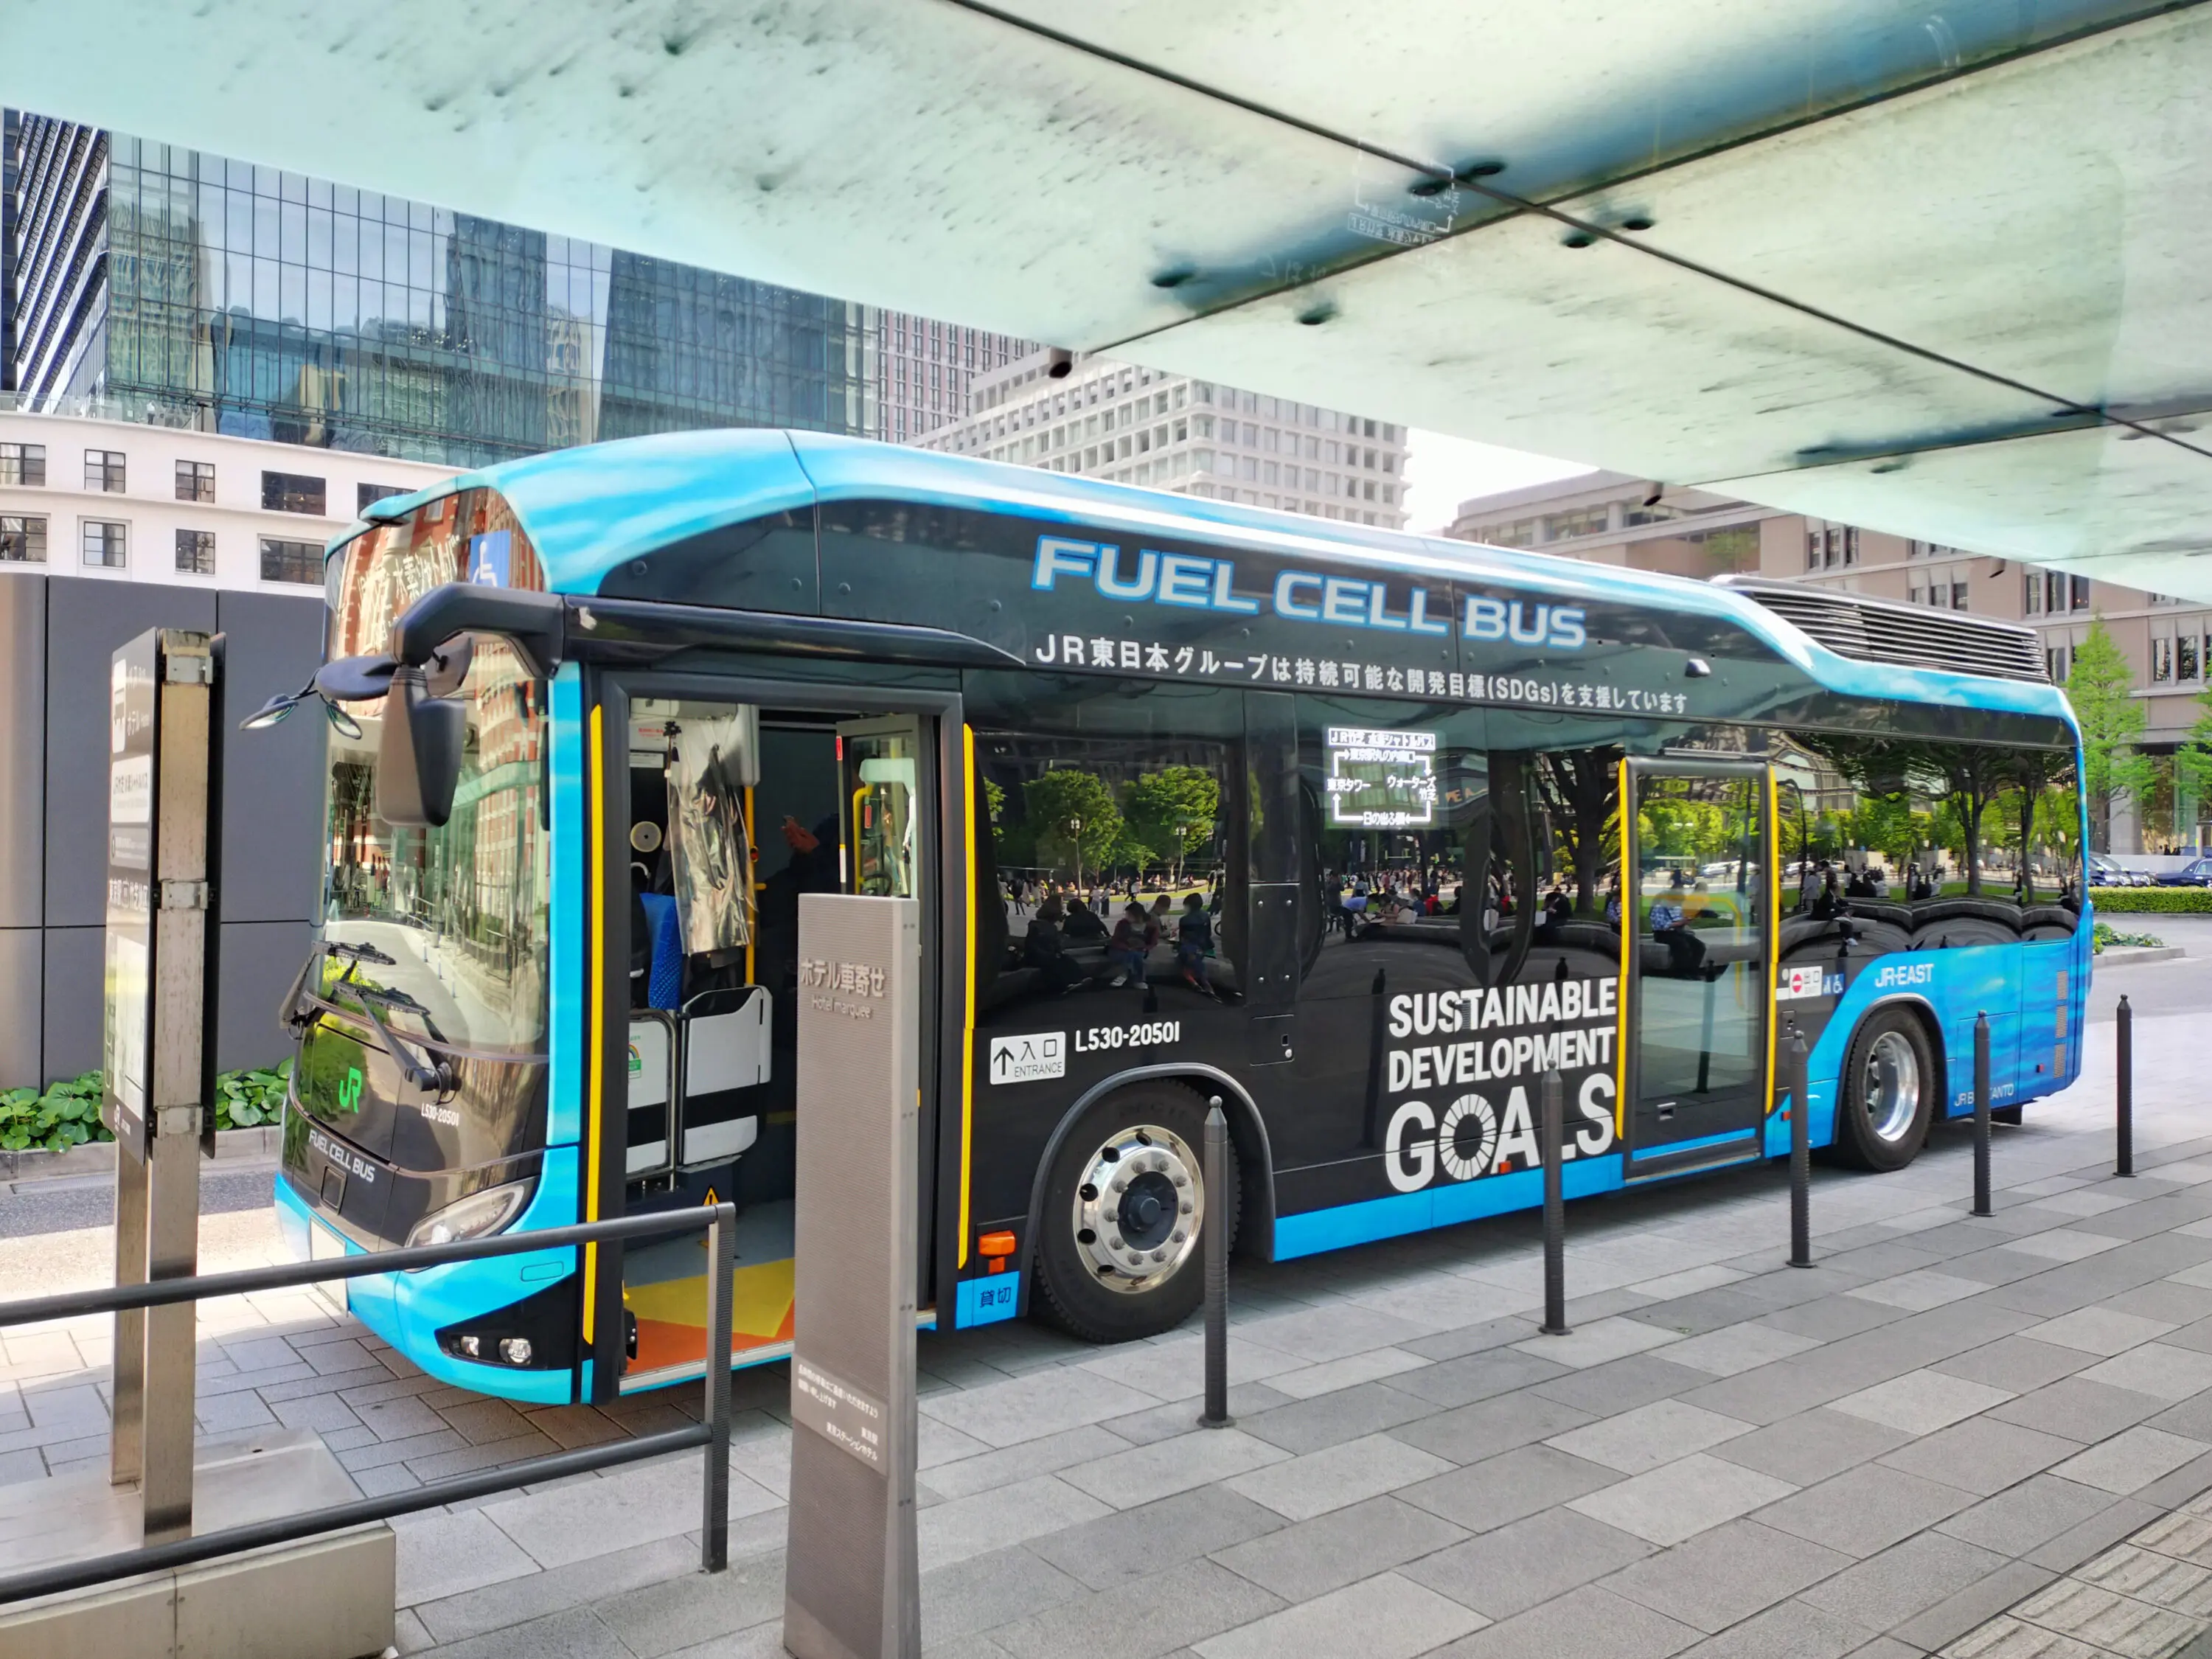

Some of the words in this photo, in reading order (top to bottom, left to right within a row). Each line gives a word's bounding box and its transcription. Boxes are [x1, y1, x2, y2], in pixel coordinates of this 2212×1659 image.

[1032, 535, 1259, 614] FUEL
[1273, 569, 1450, 637] CELL
[1463, 594, 1587, 650] BUS
[1036, 633, 1688, 715] JR東日本グループは持続可能な開発目標(SDGs)を支援しています
[1327, 778, 1371, 792] 東京タワー
[1387, 775, 1437, 789] ウォーターズ
[801, 959, 885, 997] ホテル車寄せ
[1389, 977, 1617, 1037] SUSTAINABLE
[1020, 1039, 1057, 1061] 入口
[1076, 1021, 1180, 1051] L530-20501
[1014, 1062, 1062, 1077] ENTRANCE
[1388, 1026, 1616, 1092] DEVELOPMENT
[339, 1067, 362, 1113] JR
[421, 1103, 459, 1127] L530-20501
[1385, 1073, 1615, 1192] GOAS
[309, 1129, 329, 1155] FUEL
[329, 1142, 351, 1170] CELL
[352, 1157, 375, 1183] BUS
[979, 1287, 1012, 1308] 貸切
